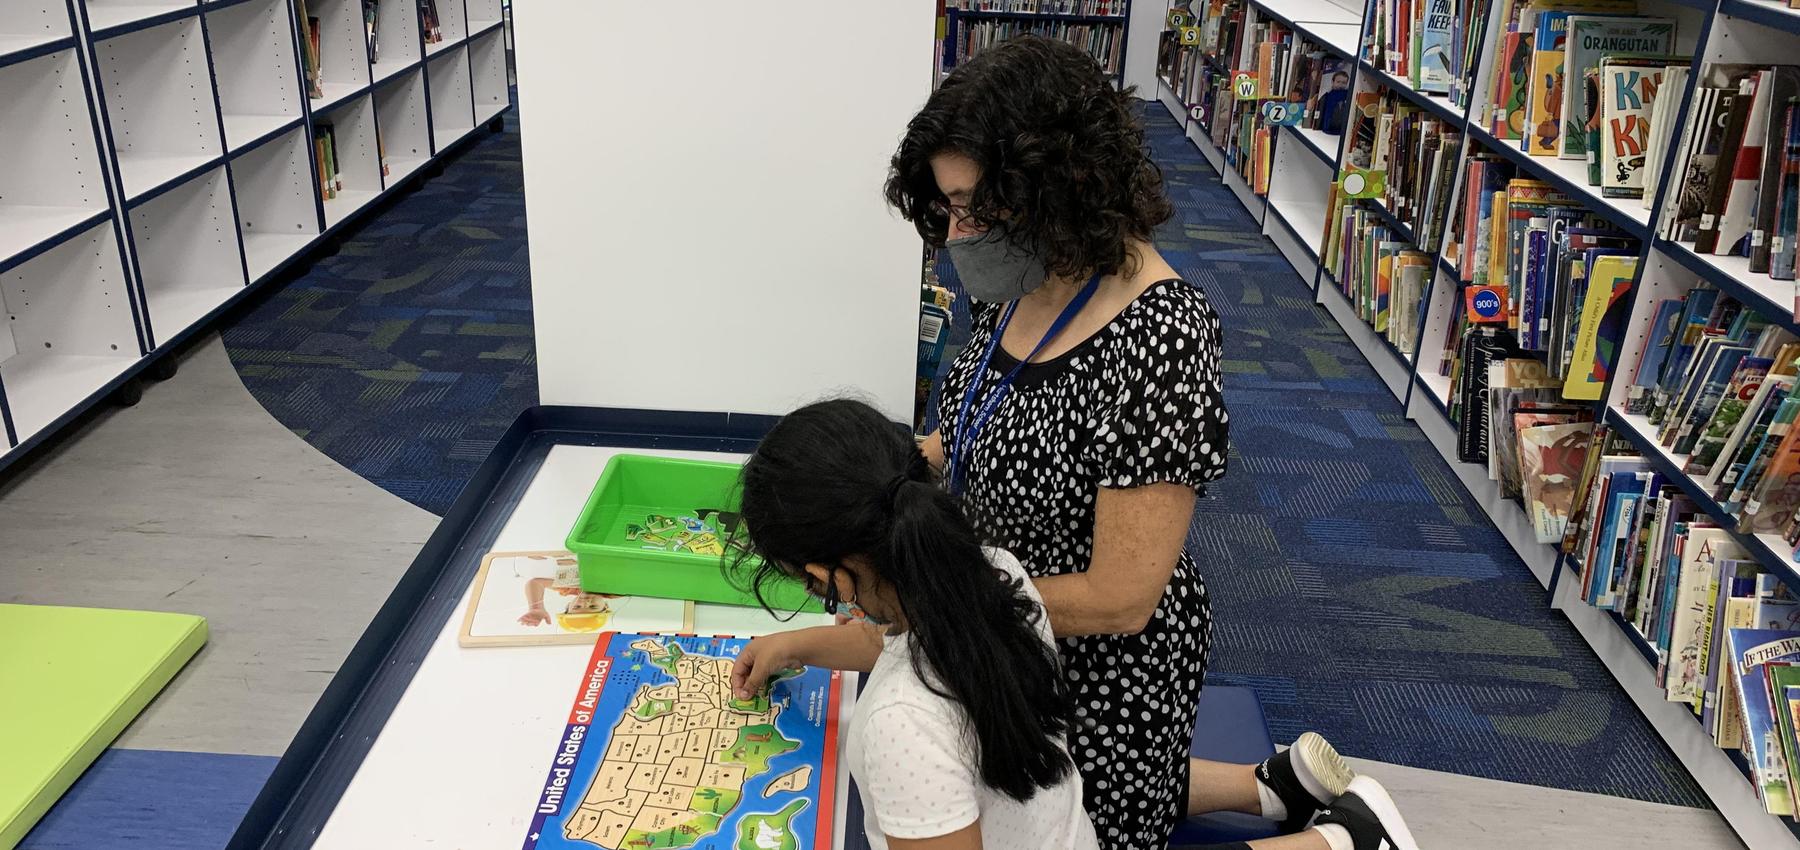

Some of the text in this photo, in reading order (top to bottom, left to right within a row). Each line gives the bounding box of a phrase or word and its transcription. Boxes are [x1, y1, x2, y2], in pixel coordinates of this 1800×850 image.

[1174, 16, 1180, 24] R
[1187, 31, 1194, 41] S
[1584, 35, 1659, 52] ORANGUTAN
[1241, 84, 1252, 95] W
[1194, 108, 1202, 117] T
[1273, 108, 1282, 120] Z
[1476, 300, 1498, 308] 900's
[1744, 652, 1755, 666] IF
[1756, 645, 1780, 661] THE
[538, 660, 609, 814] United States of America
